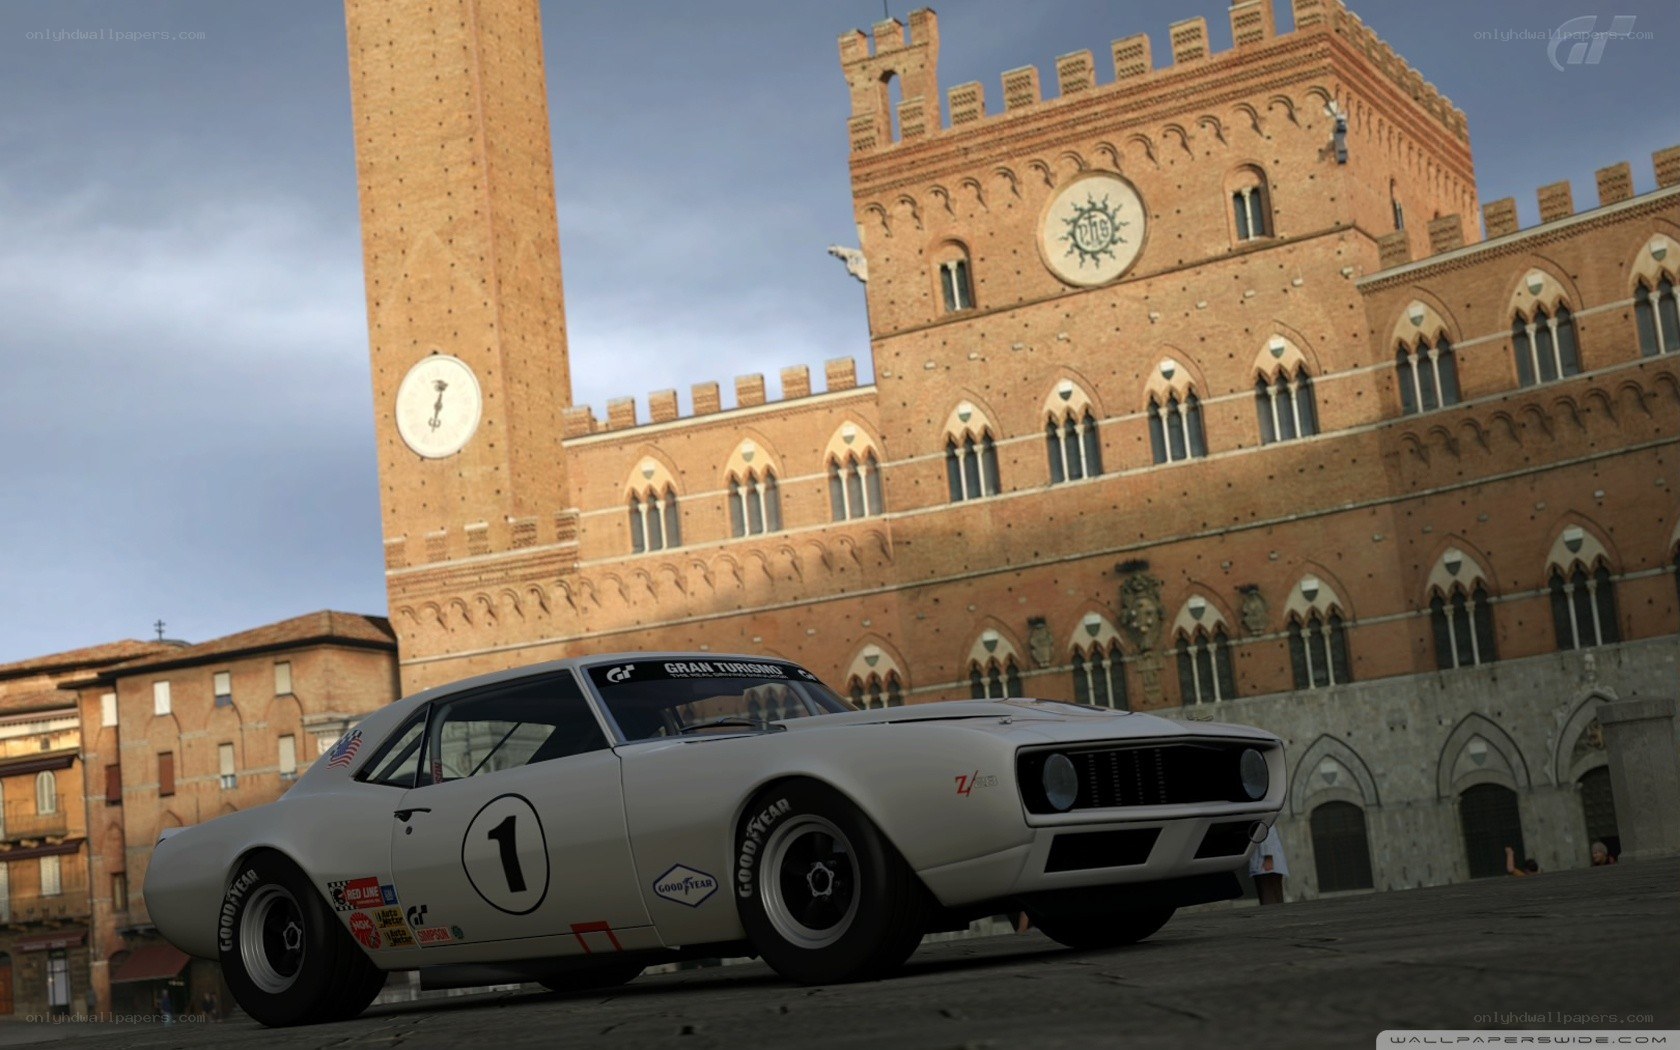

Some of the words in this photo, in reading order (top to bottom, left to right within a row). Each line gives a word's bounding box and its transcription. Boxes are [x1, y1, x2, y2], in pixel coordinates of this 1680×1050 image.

[664, 662, 714, 674] GRAN
[713, 662, 783, 676] TURISMO
[488, 815, 527, 892] 1
[363, 886, 379, 898] LINE
[417, 928, 450, 942] SIMPSON
